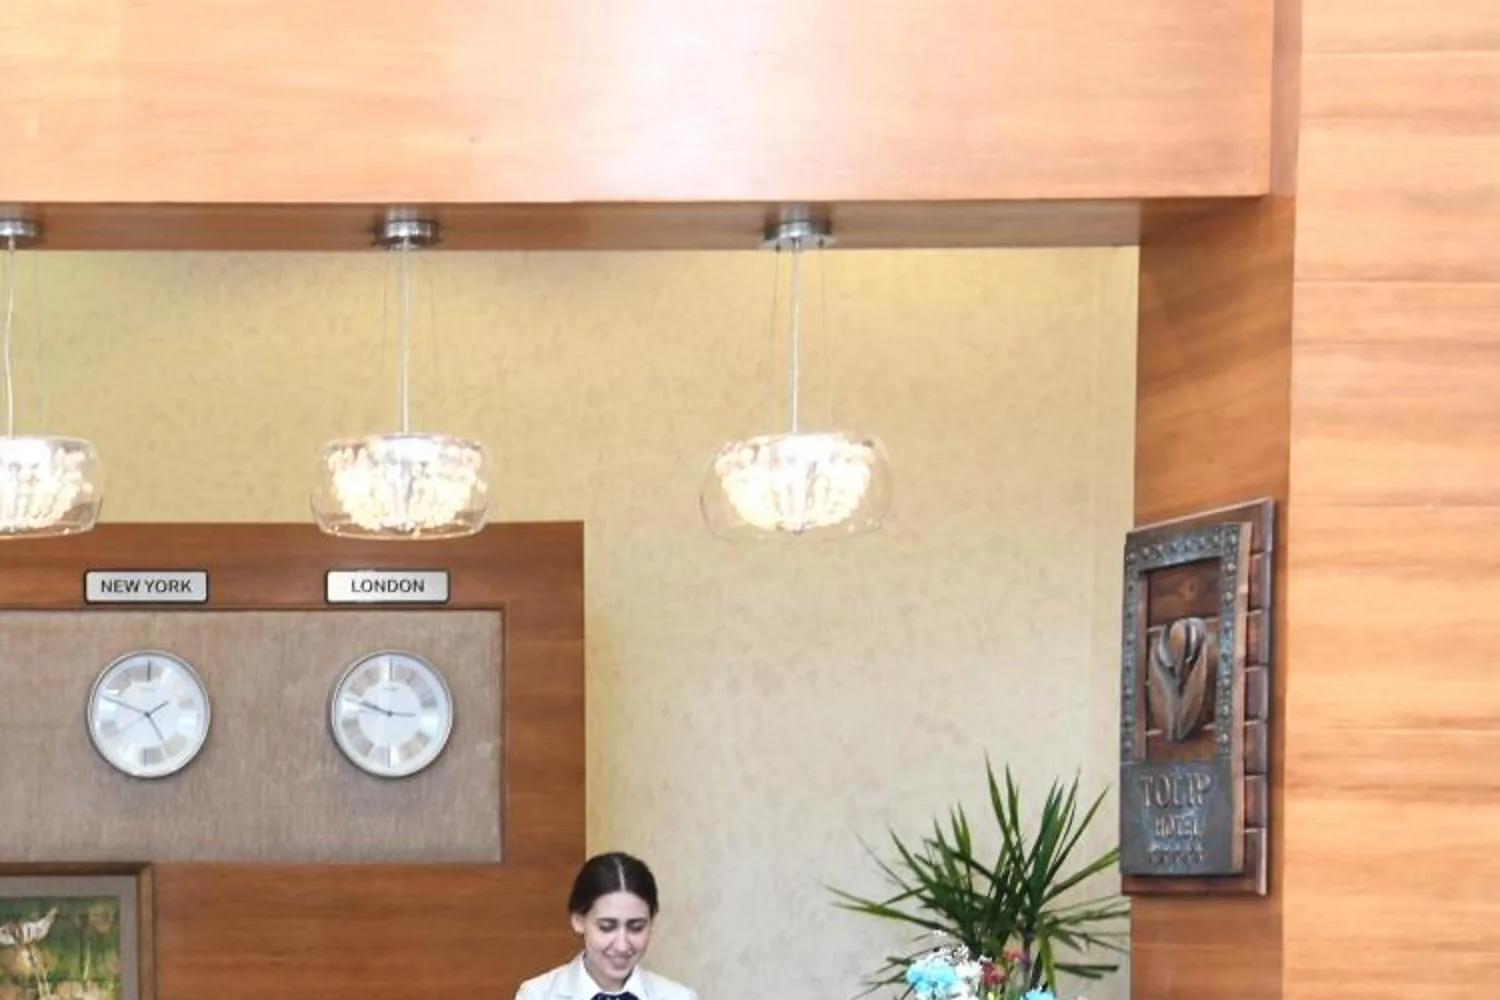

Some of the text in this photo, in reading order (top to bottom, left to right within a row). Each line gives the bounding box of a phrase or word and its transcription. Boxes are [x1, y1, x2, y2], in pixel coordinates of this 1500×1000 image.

[101, 579, 192, 593] NEW YORK
[351, 579, 426, 593] LONDON
